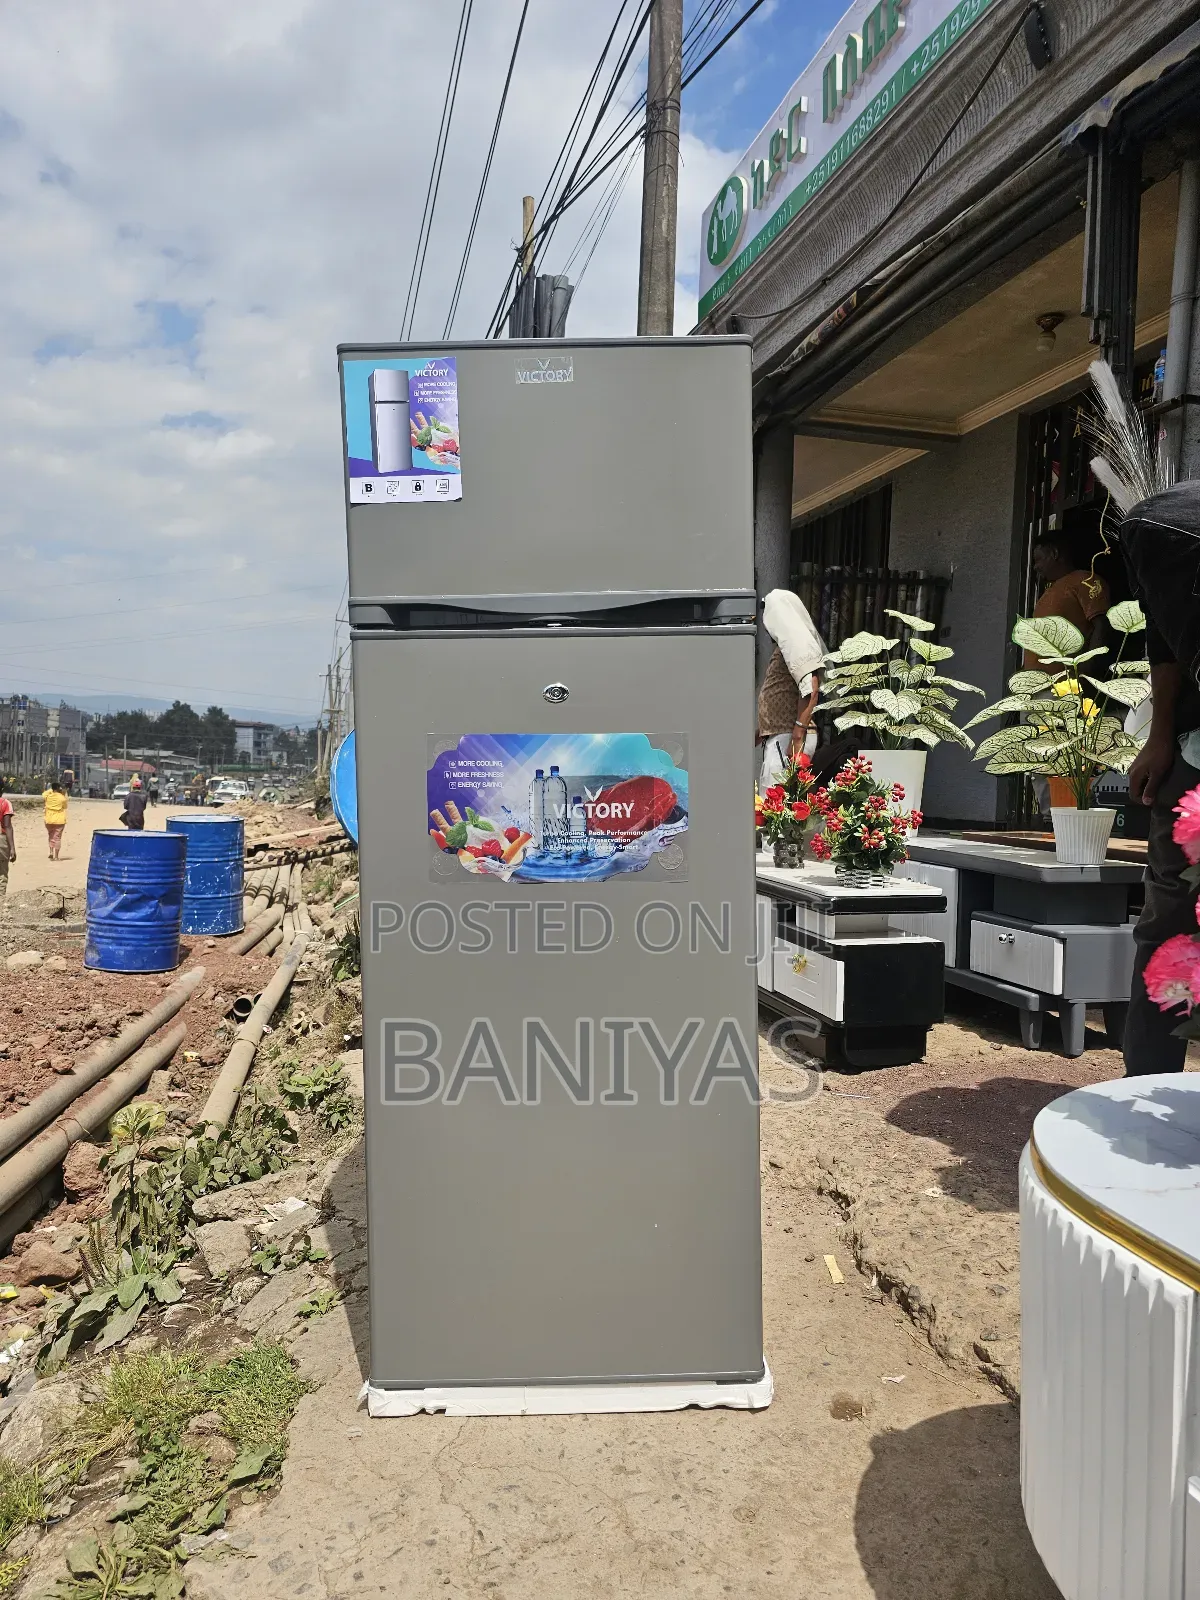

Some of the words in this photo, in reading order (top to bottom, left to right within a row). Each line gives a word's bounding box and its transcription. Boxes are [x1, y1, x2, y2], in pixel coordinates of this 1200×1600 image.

[910, 0, 988, 76] +251929
[414, 368, 449, 377] VICTORY
[517, 367, 572, 382] VICTORY
[457, 781, 481, 789] ENERGY
[552, 802, 635, 819] VICTORY
